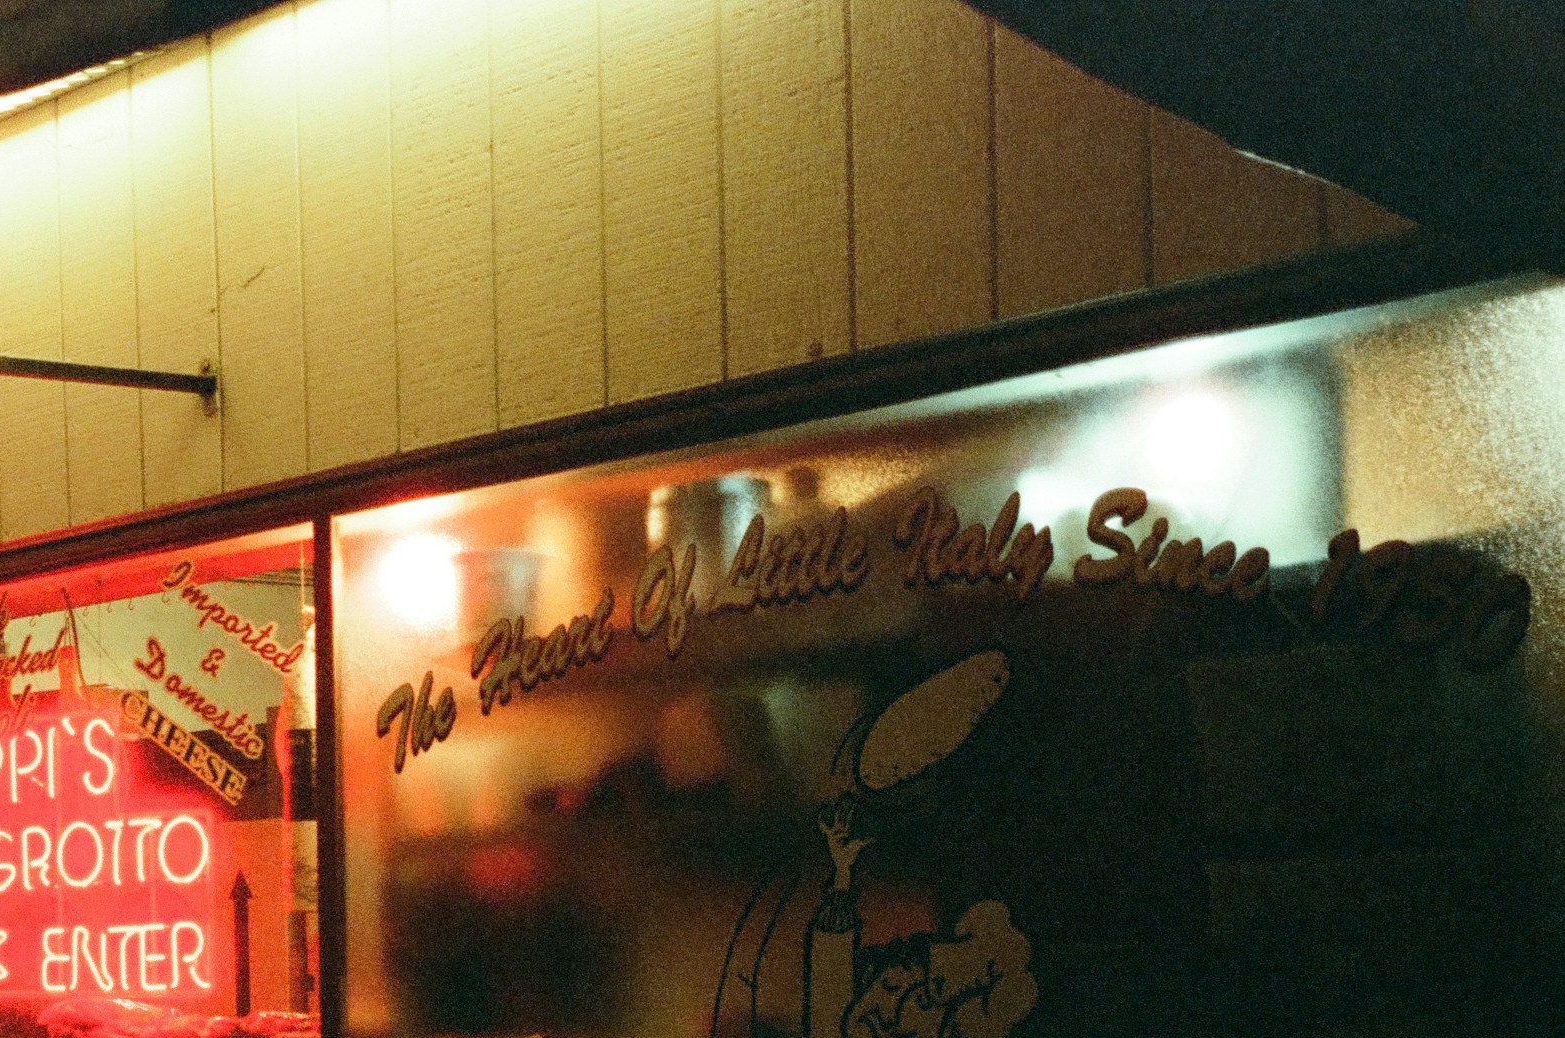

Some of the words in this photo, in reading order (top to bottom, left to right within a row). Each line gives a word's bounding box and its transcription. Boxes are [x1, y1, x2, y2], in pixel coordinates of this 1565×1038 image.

[162, 560, 305, 674] Imported
[200, 647, 226, 679] &
[376, 670, 457, 775] The
[471, 588, 615, 717] Heart
[633, 541, 698, 660] Of
[711, 505, 870, 621] Little
[893, 486, 1055, 599] Italy
[1072, 486, 1271, 599] Since
[1309, 527, 1534, 671] 1950
[121, 691, 247, 806] CHEESE
[134, 636, 264, 760] Domestic
[41, 920, 211, 994] ENTER
